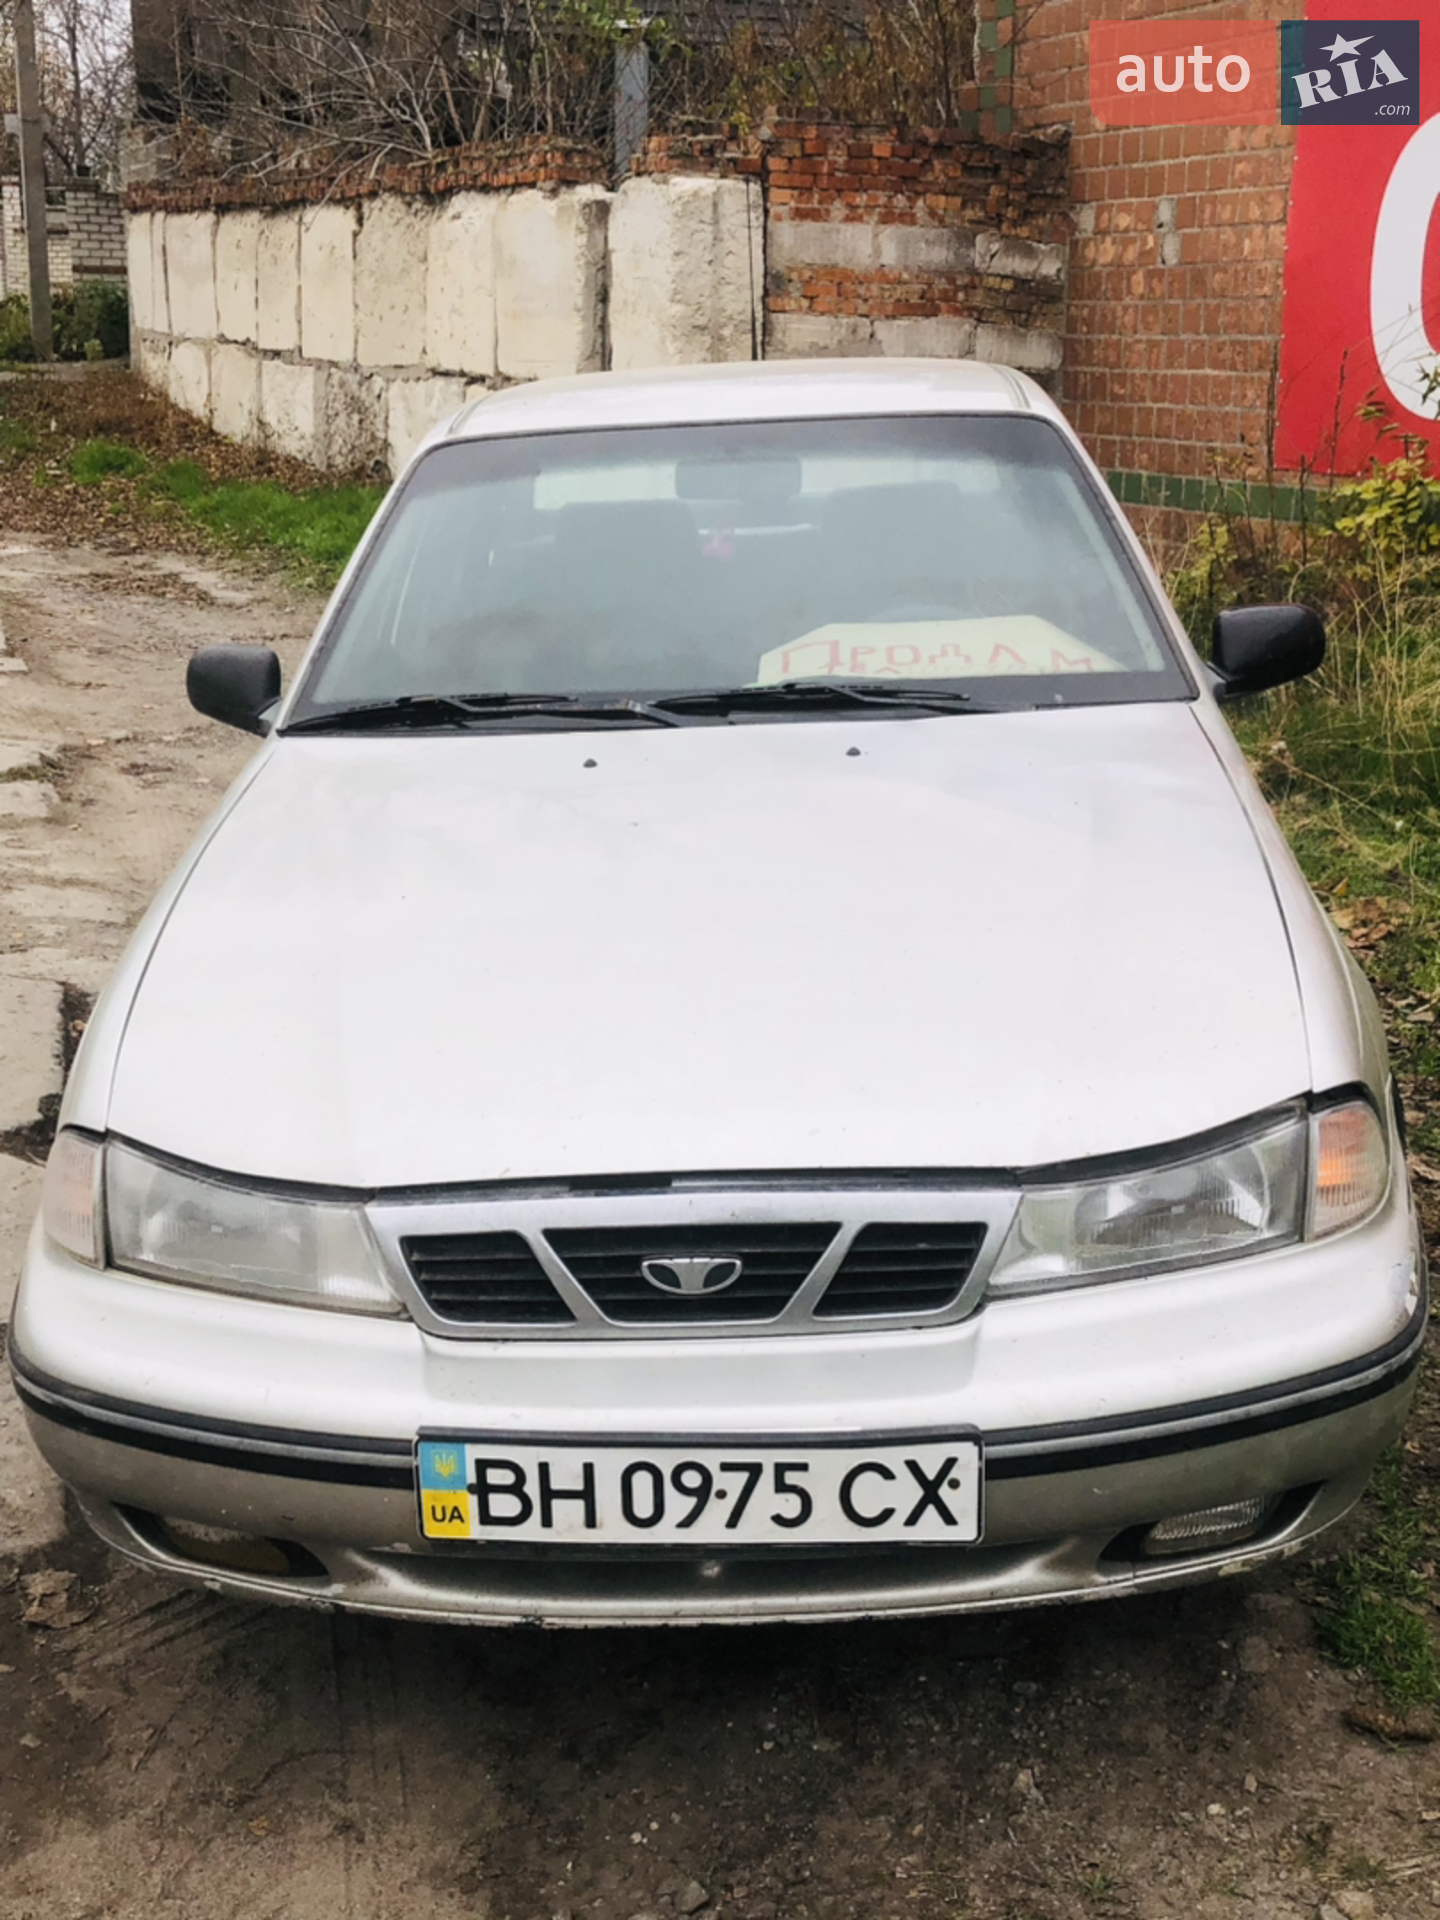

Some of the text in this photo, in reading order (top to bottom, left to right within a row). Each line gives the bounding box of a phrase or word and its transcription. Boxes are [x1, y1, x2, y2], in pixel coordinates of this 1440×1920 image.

[431, 1505, 465, 1524] UA
[475, 1457, 959, 1529] BH 0975 CX
